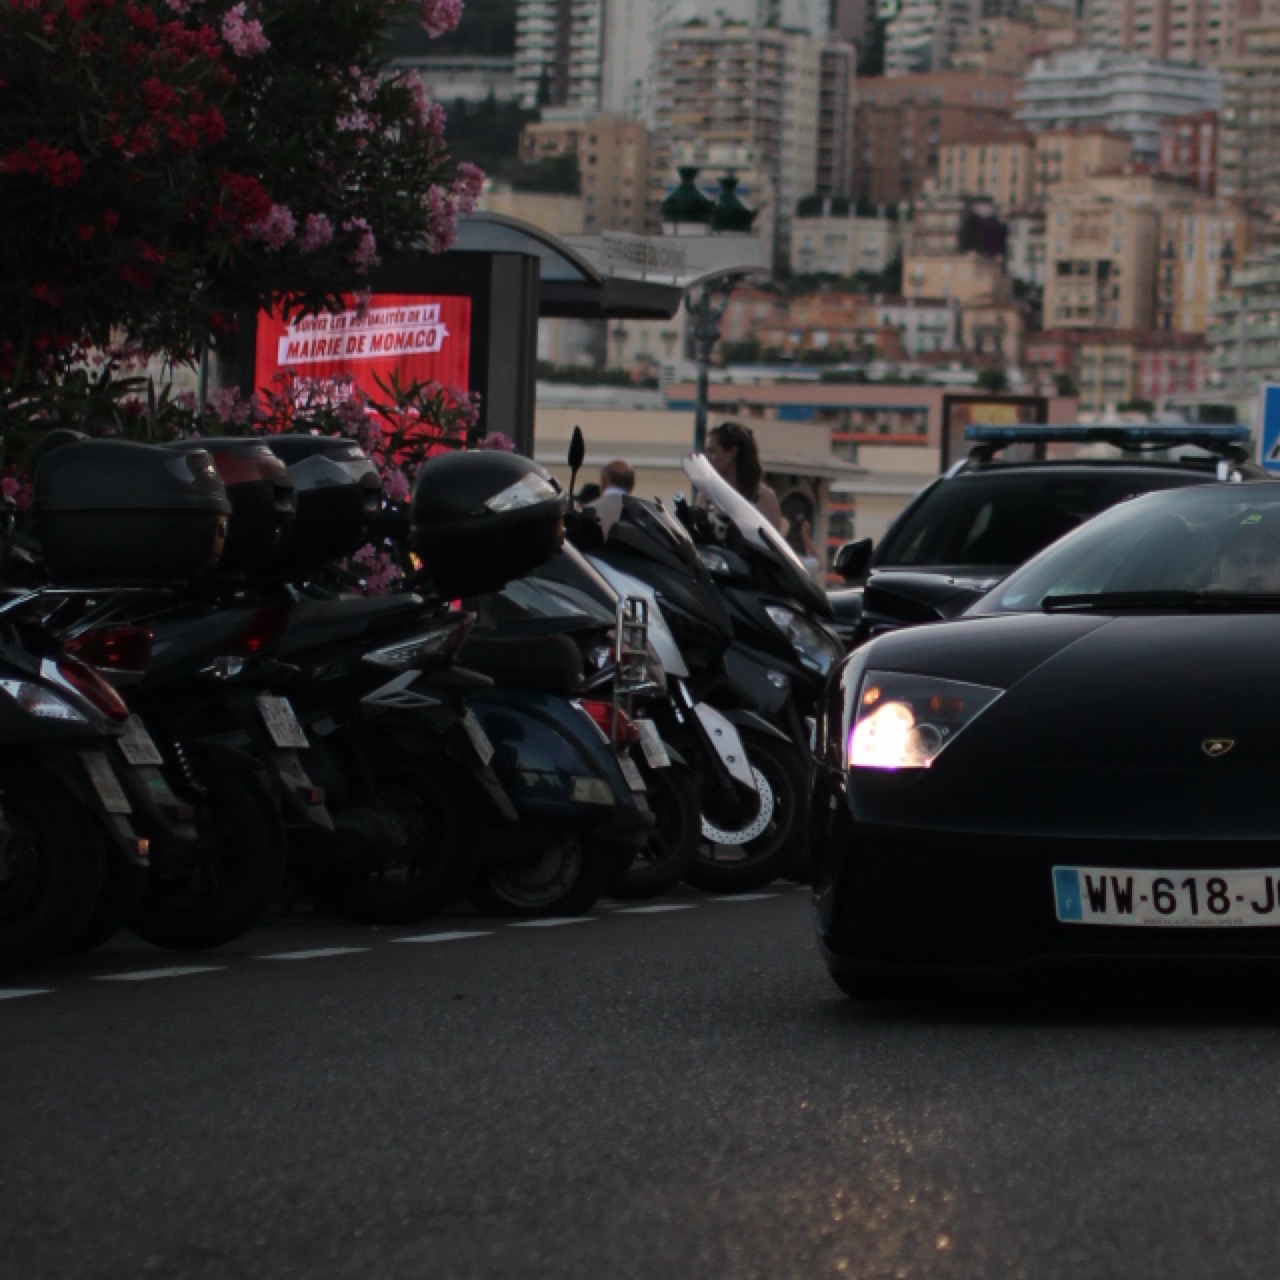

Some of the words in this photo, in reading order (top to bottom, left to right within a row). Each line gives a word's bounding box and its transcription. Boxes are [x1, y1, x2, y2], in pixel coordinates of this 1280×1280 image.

[408, 310, 420, 322] DE
[423, 308, 434, 321] LA
[286, 337, 342, 359] MAIRIE
[346, 335, 366, 354] DE
[370, 329, 437, 352] MONACO
